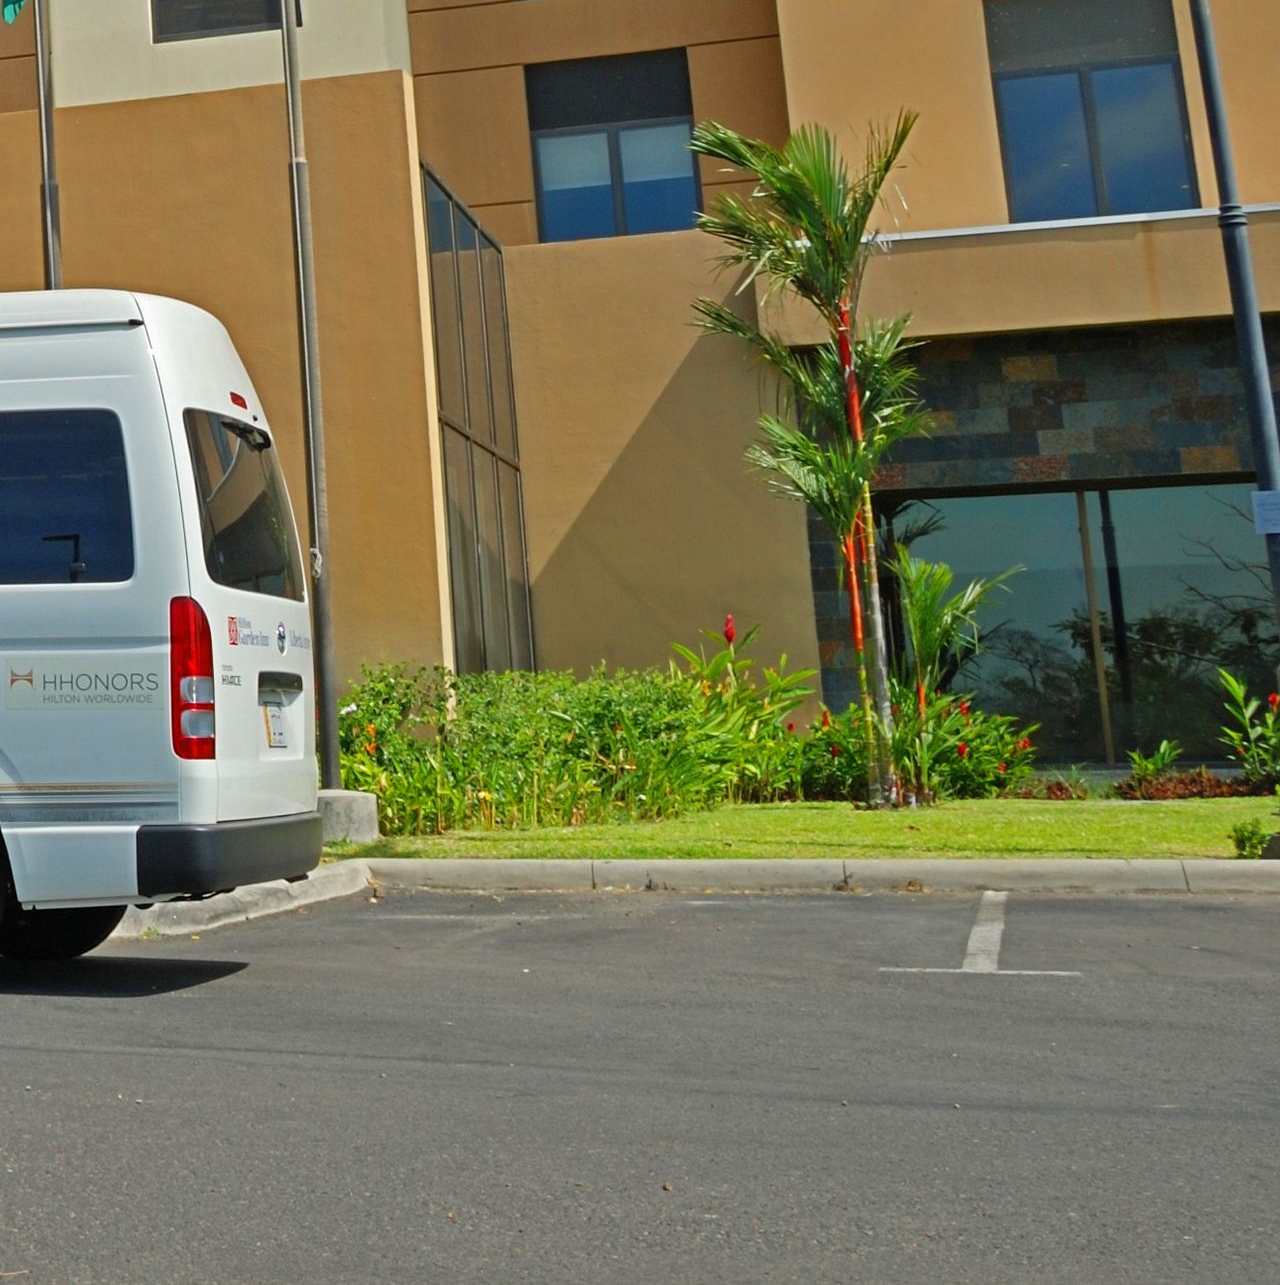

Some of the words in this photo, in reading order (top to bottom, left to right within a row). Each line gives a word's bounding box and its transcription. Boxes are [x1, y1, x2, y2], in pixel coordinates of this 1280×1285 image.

[43, 673, 159, 691] HHONORS
[43, 694, 80, 704] HILTON
[85, 694, 153, 704] WORLDWIDE
